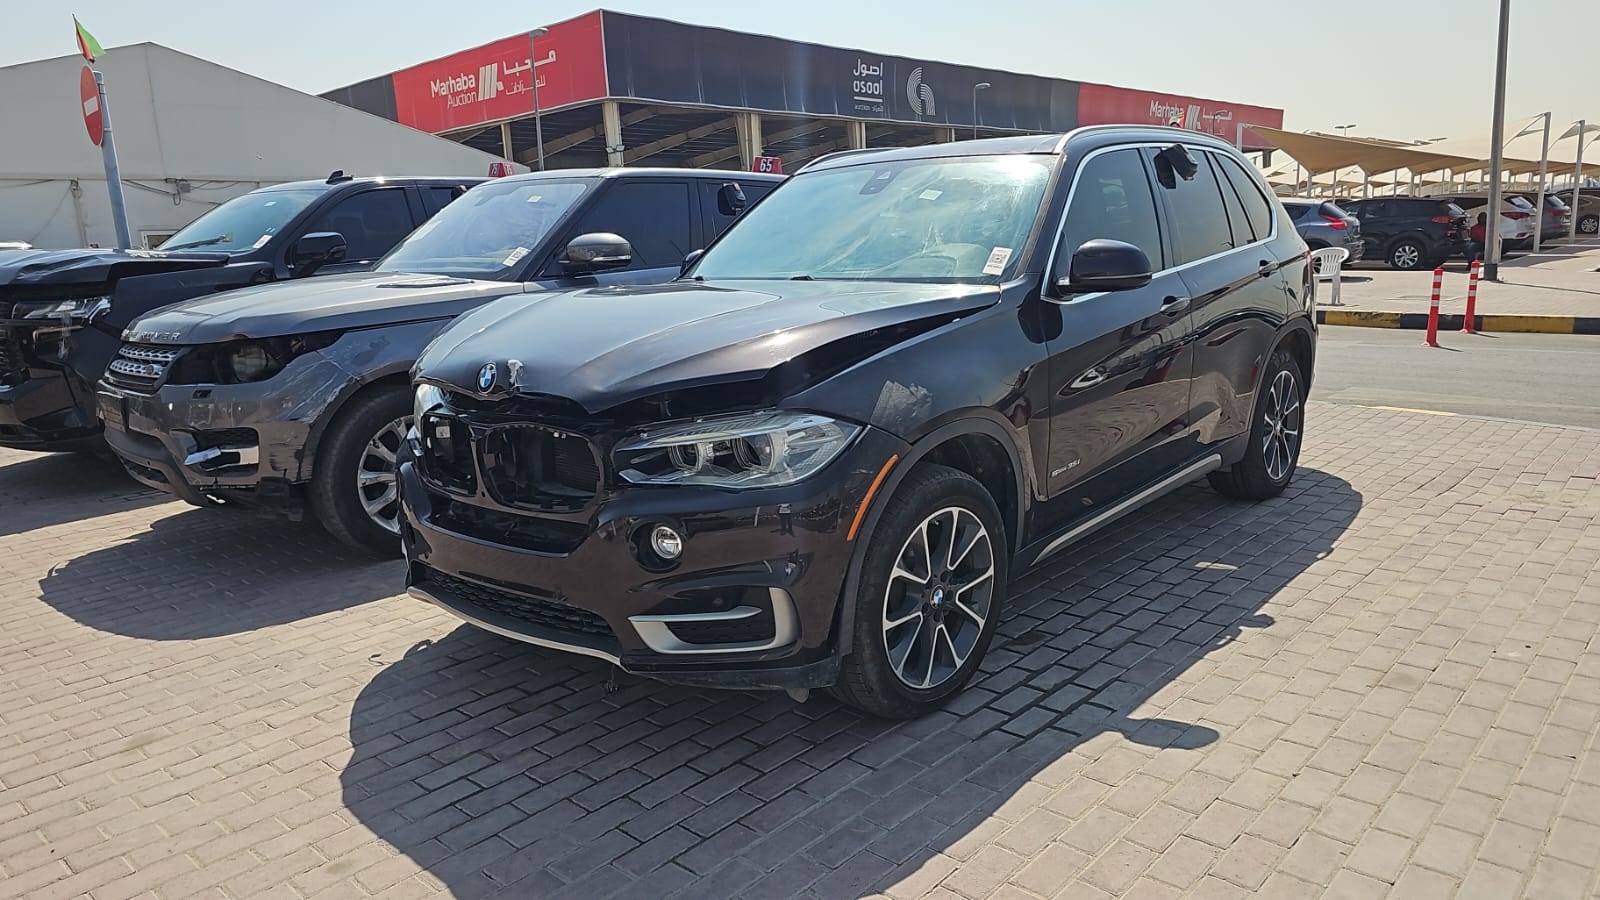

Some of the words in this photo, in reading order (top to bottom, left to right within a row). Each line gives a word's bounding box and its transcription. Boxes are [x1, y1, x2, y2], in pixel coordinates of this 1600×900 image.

[503, 49, 556, 76] محبا
[853, 58, 883, 77] اصول
[430, 73, 476, 98] Marhaba
[447, 91, 478, 109] Auction
[760, 158, 773, 172] 65
